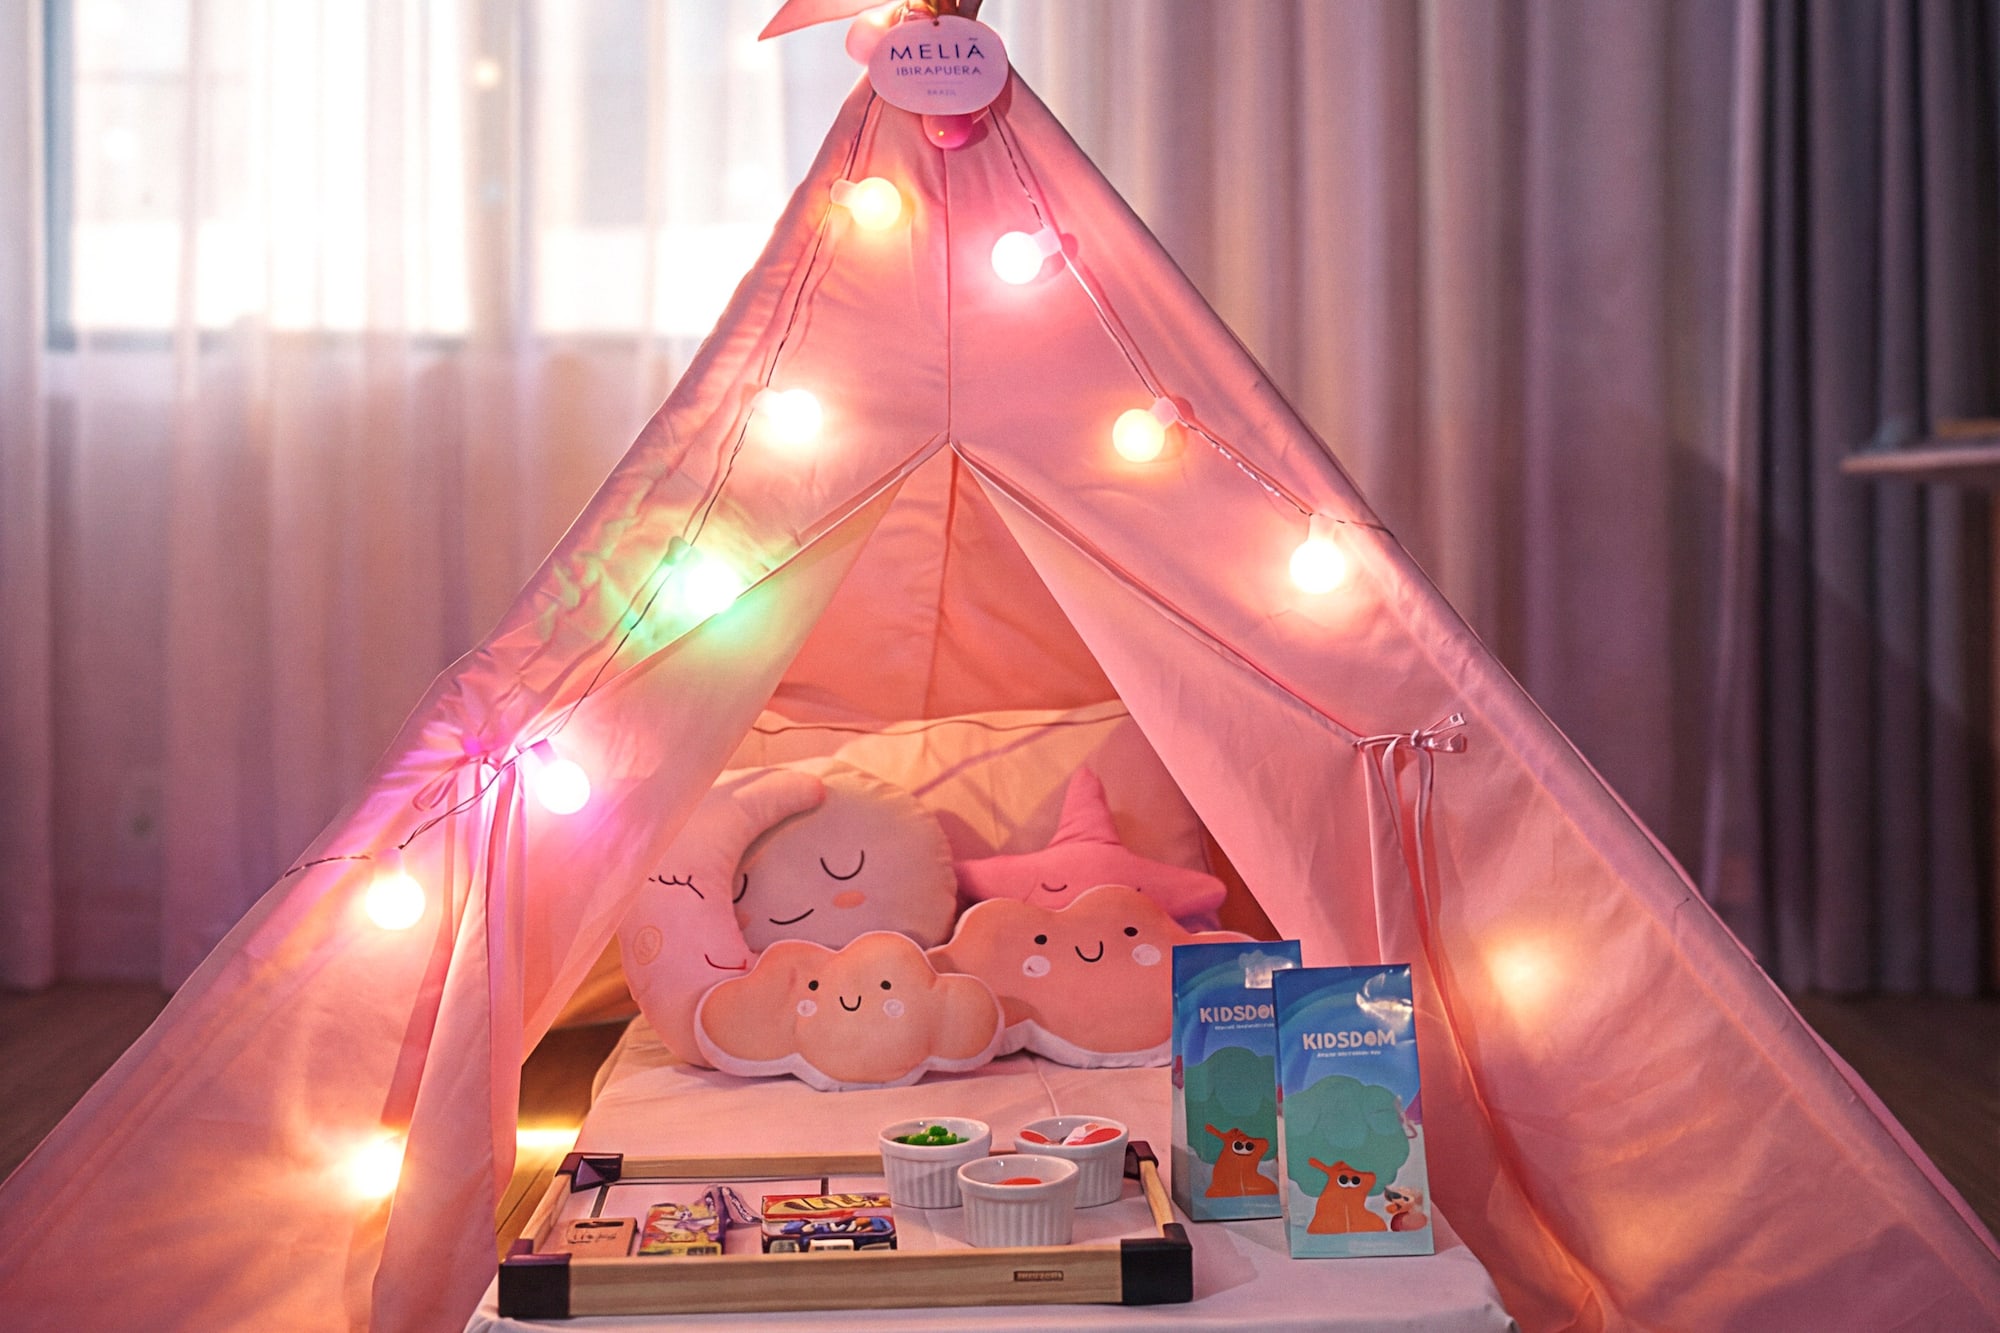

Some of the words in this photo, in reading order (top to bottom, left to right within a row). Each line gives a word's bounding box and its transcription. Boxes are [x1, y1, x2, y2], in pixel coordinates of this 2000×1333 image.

[896, 65, 982, 76] IBIRAPUERA
[1200, 1004, 1274, 1023] KIDSDO
[1303, 1029, 1396, 1050] KIDSDOM
